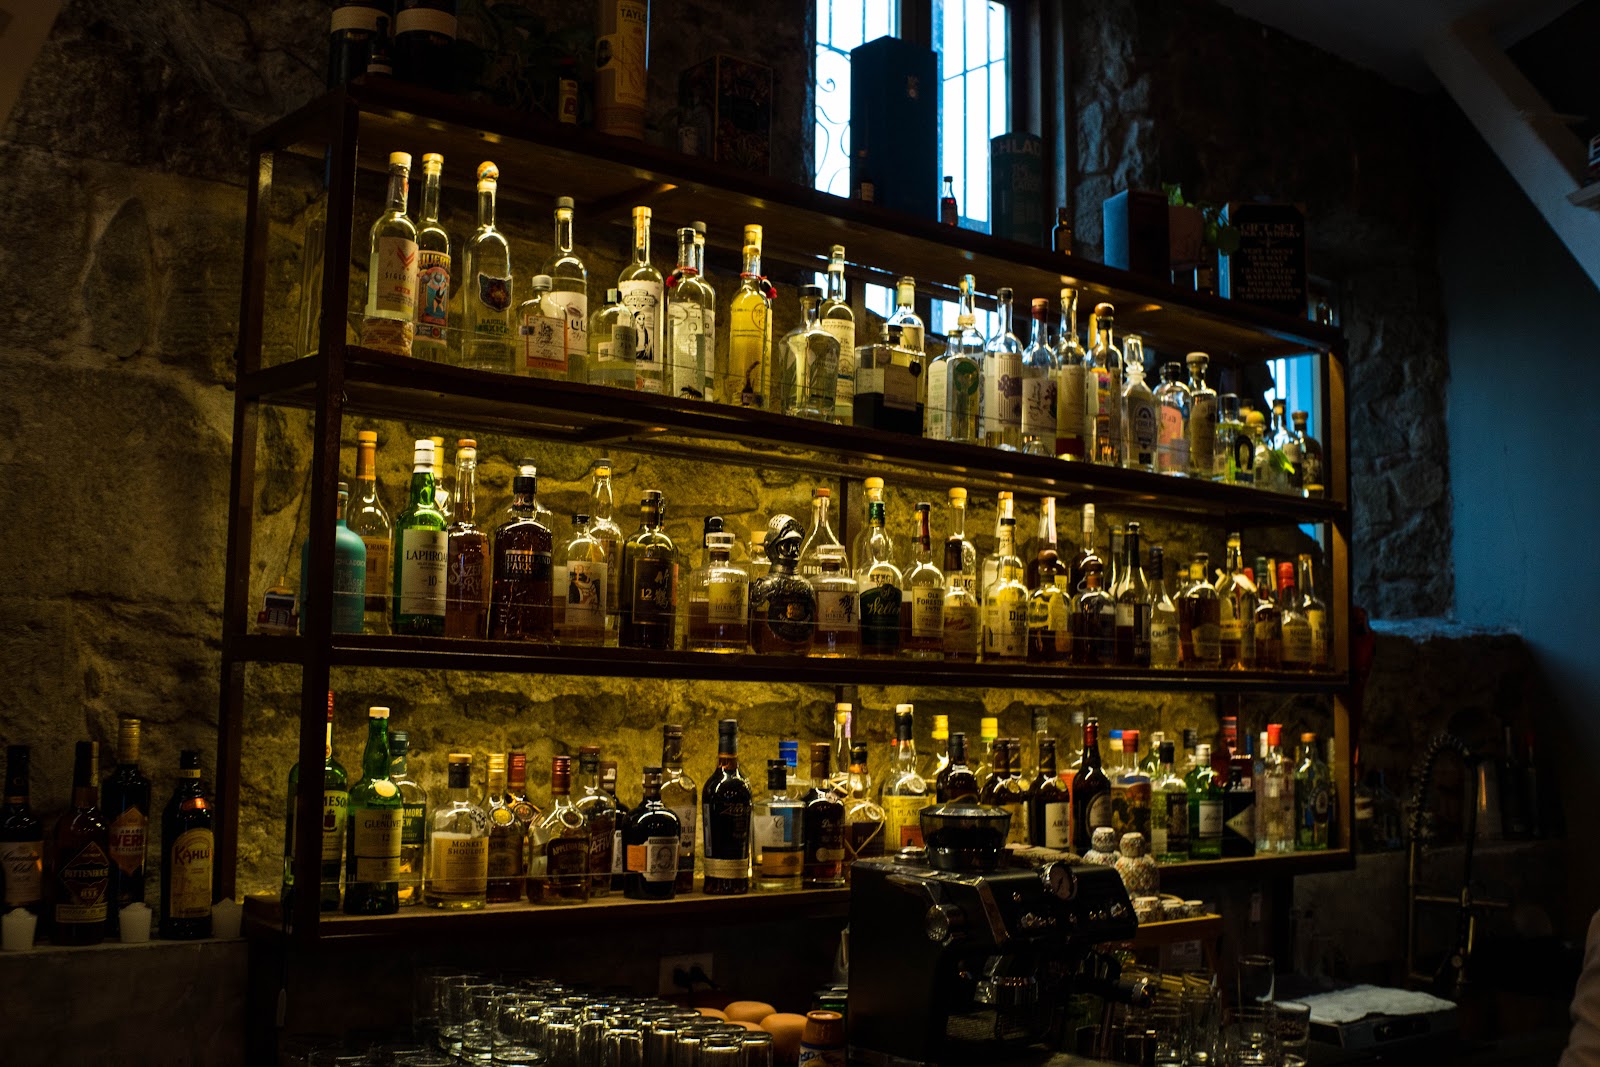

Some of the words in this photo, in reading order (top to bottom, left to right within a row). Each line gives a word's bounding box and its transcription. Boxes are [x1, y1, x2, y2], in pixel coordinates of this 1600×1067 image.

[507, 554, 552, 565] HIGHLAND
[507, 562, 533, 575] PARK
[428, 575, 438, 587] 10
[641, 588, 653, 599] 12
[451, 840, 484, 849] MONKEY
[447, 847, 486, 856] SHOULDER
